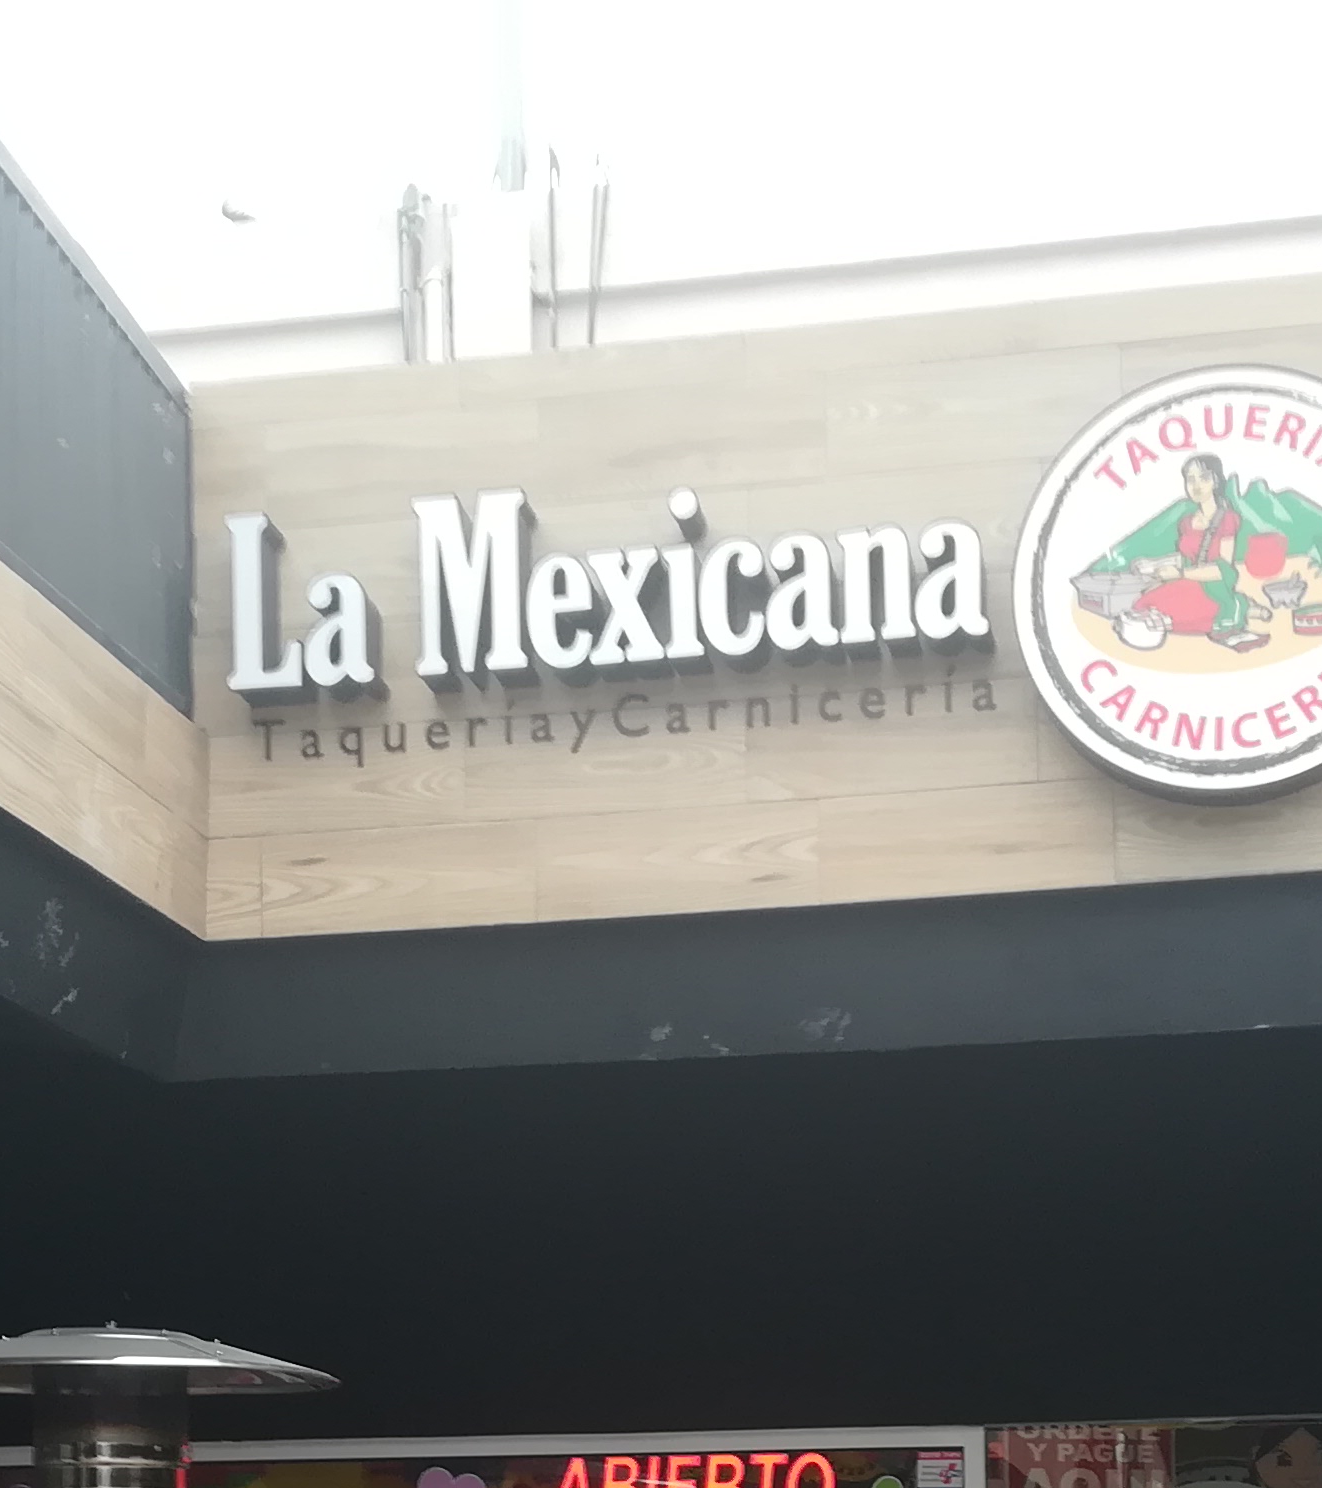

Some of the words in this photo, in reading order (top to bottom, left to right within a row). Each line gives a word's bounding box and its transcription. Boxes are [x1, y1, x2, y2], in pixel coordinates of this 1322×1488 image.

[226, 511, 375, 692] La
[412, 486, 989, 676] Mexicana
[1026, 1443, 1048, 1462] Y
[1057, 1442, 1155, 1463] PAGUE
